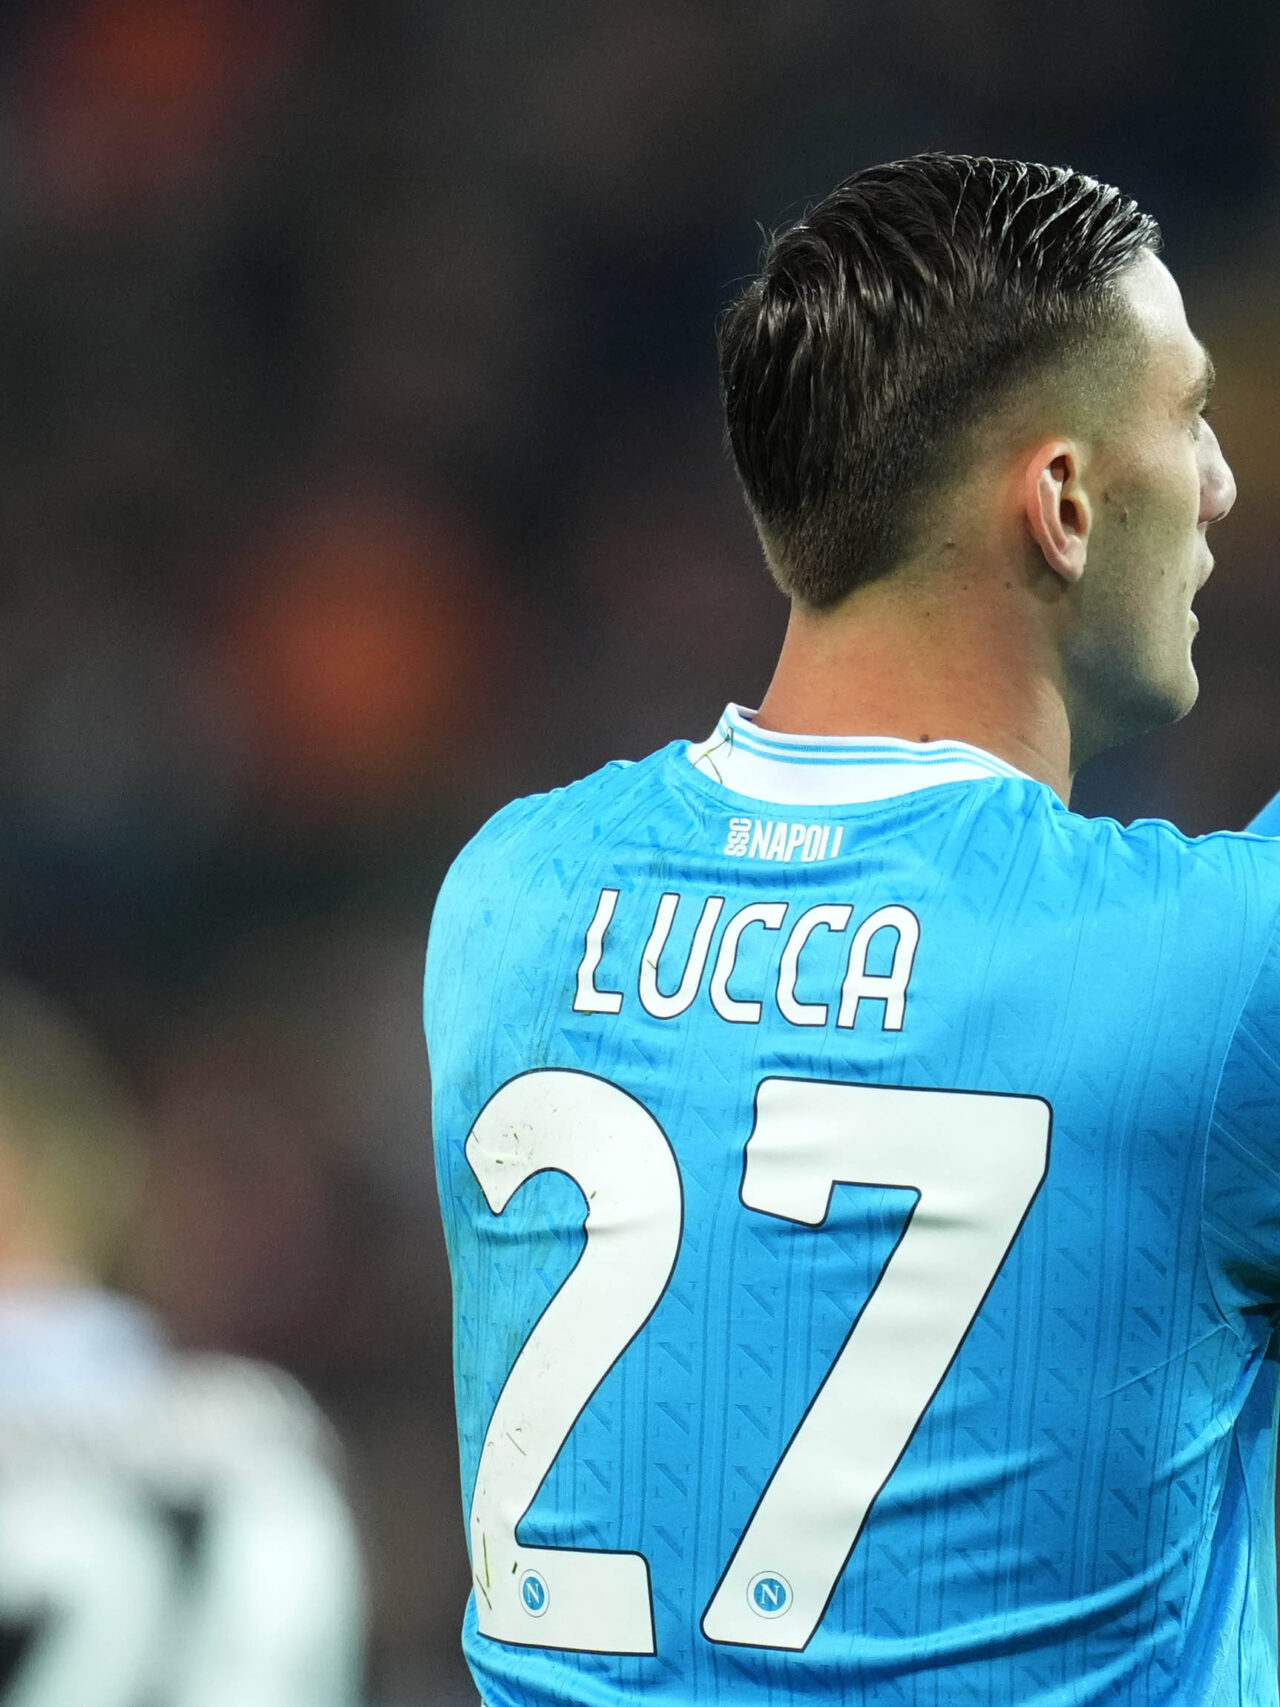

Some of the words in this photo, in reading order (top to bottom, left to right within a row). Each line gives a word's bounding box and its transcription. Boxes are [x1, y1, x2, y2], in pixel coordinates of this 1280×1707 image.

[724, 817, 752, 857] SSC
[748, 819, 844, 863] NAPOLI
[572, 888, 921, 1032] LUCCA
[465, 1067, 1052, 1657] 27
[760, 1583, 781, 1605] N
